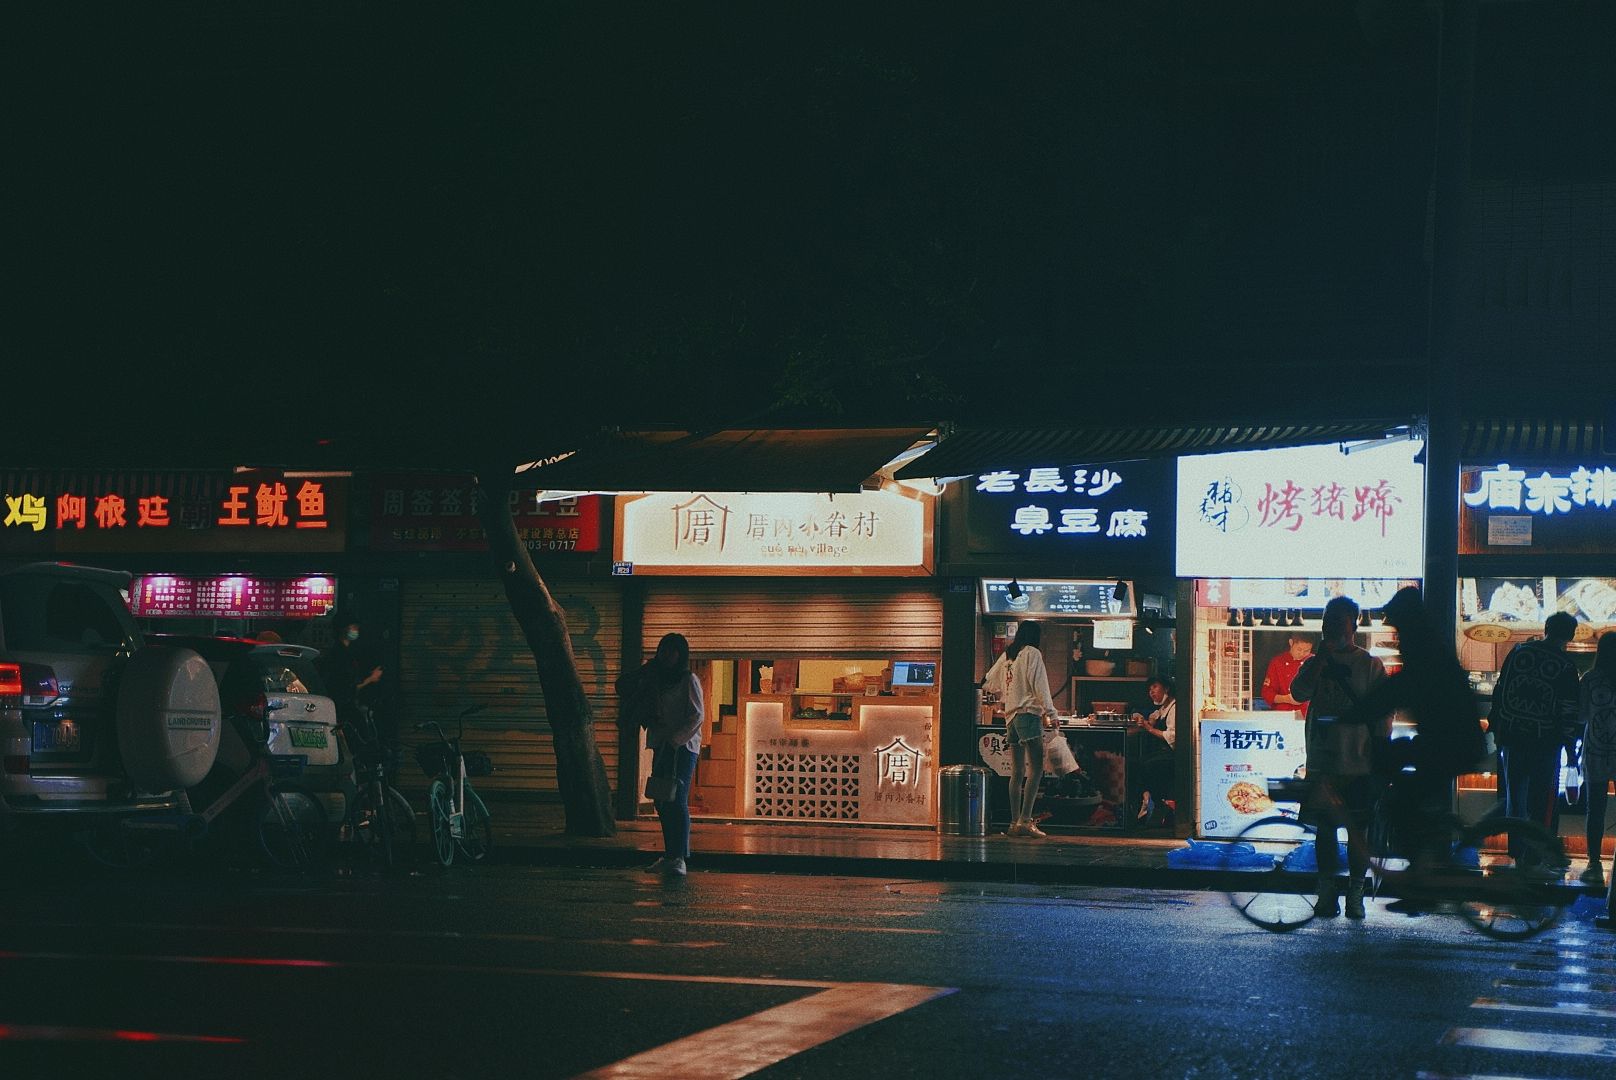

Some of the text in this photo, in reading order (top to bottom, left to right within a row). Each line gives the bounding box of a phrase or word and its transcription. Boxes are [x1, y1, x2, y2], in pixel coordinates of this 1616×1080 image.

[4, 492, 47, 532] 鸡
[1009, 504, 1149, 538] 臭豆腐
[1256, 479, 1403, 538] 烤猪蹄
[809, 543, 849, 558] village
